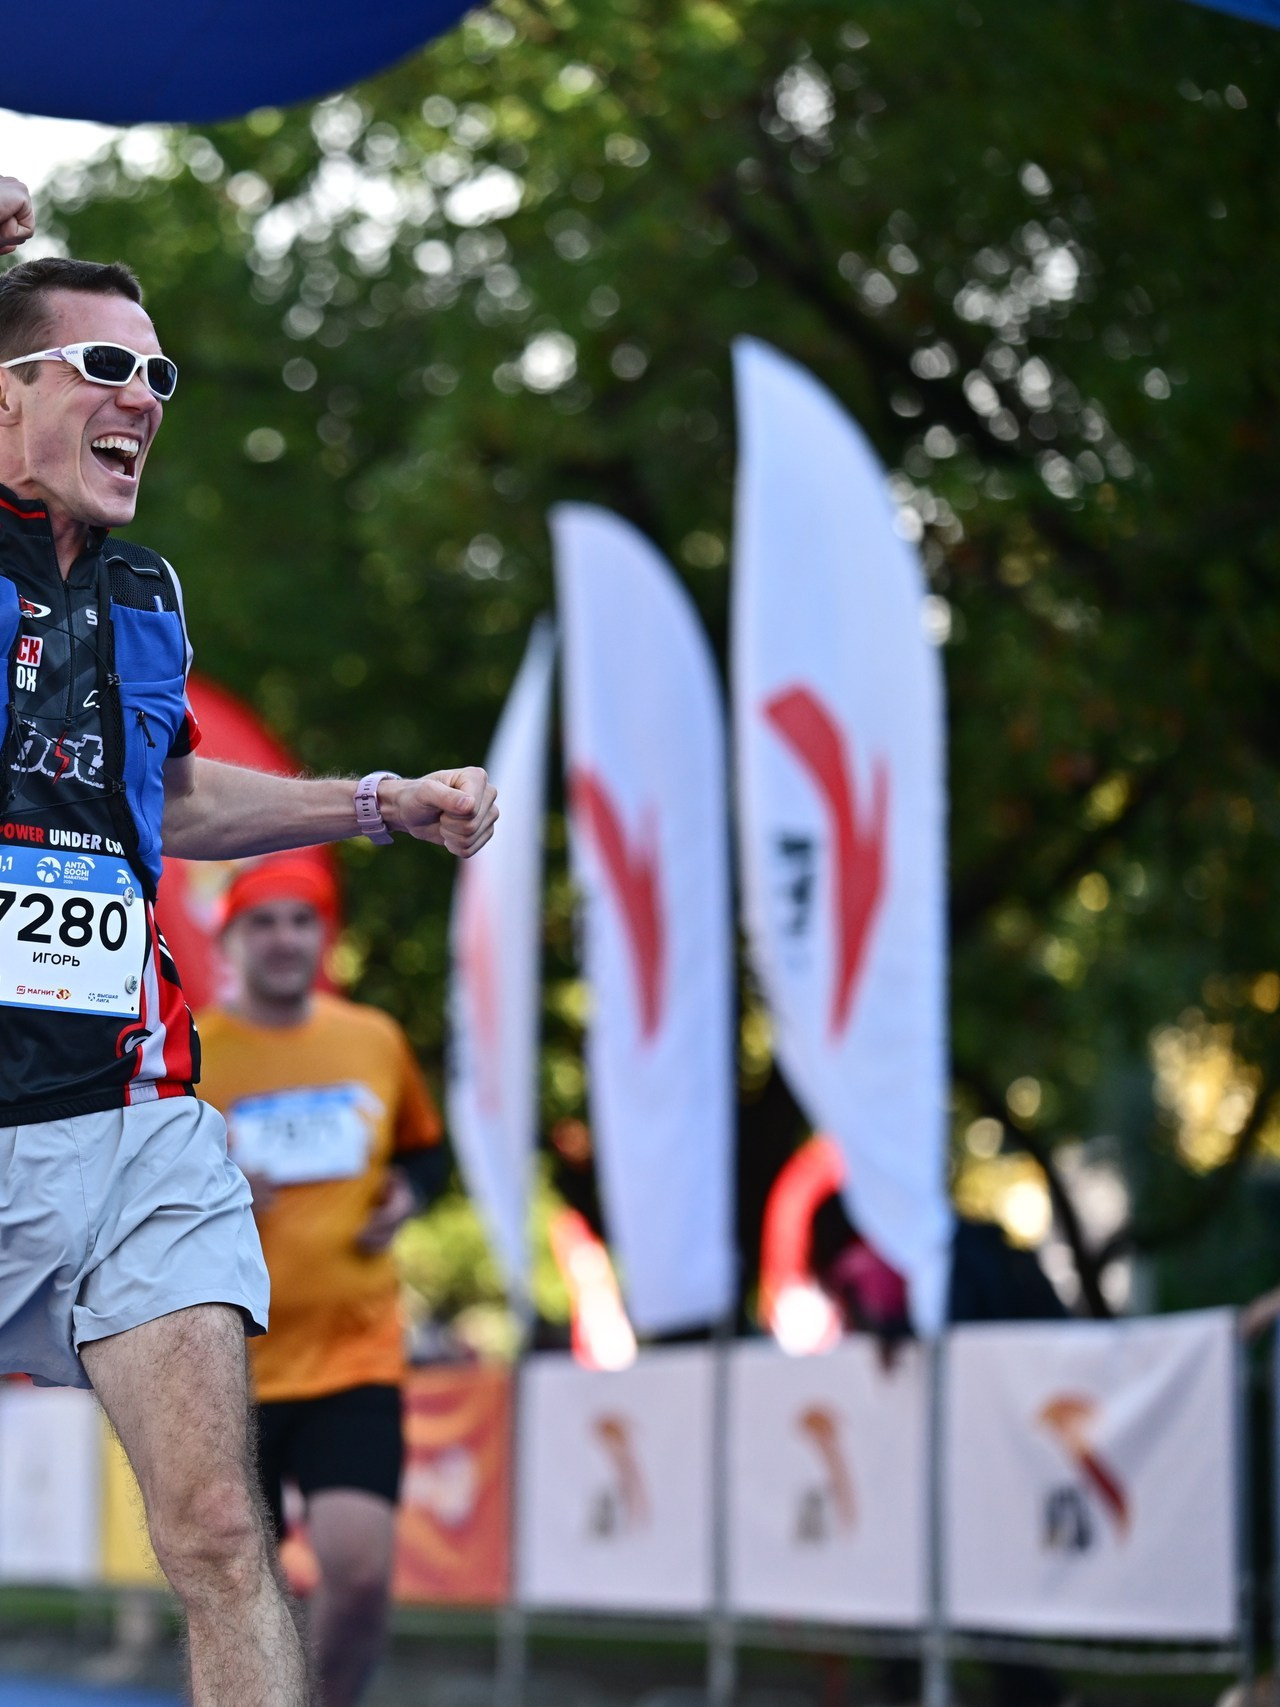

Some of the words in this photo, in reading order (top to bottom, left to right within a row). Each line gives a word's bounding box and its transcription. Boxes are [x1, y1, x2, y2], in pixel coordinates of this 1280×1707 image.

[49, 829, 102, 850] UNDER
[64, 861, 87, 870] ANTA
[63, 868, 90, 877] SOCHI
[32, 952, 80, 967] ИГОРЬ
[27, 988, 55, 996] МАГНИТ
